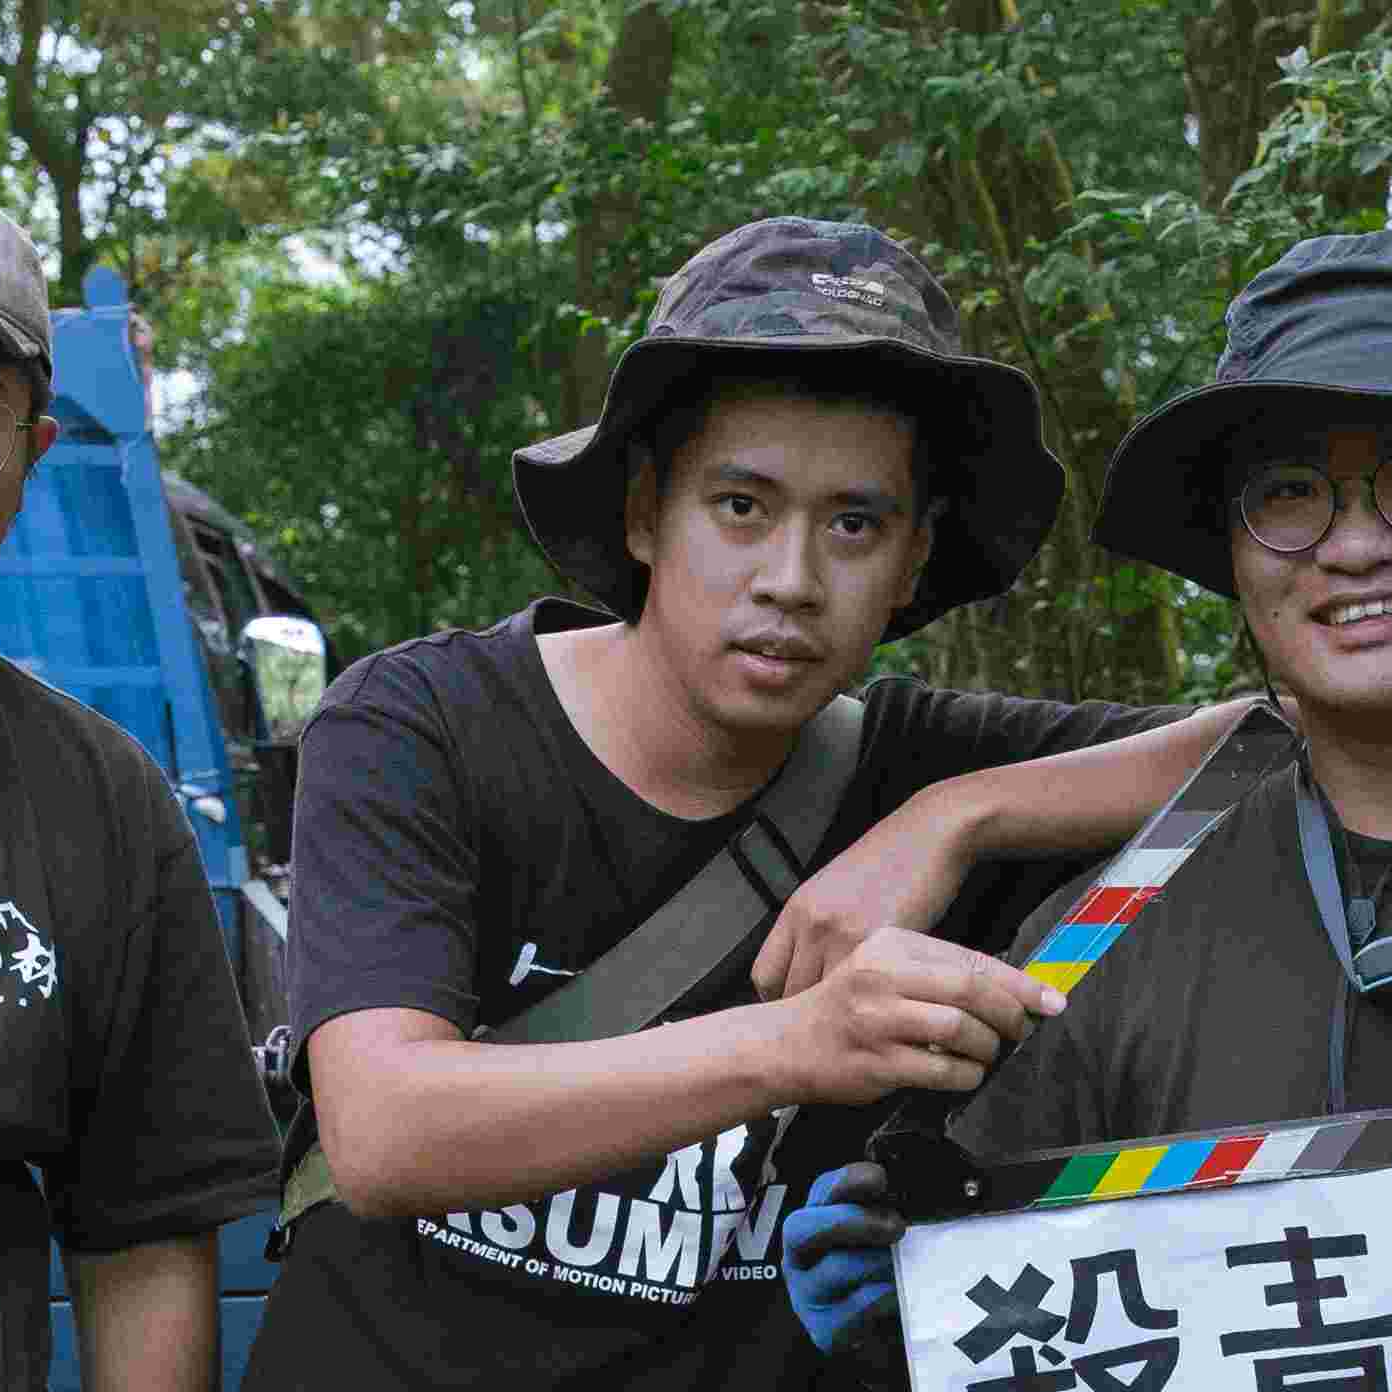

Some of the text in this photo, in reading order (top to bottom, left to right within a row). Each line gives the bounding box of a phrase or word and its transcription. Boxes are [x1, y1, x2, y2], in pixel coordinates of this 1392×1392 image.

[525, 1258, 550, 1277] OF
[552, 1264, 626, 1296] MOTION
[721, 1264, 778, 1282] VIDEO
